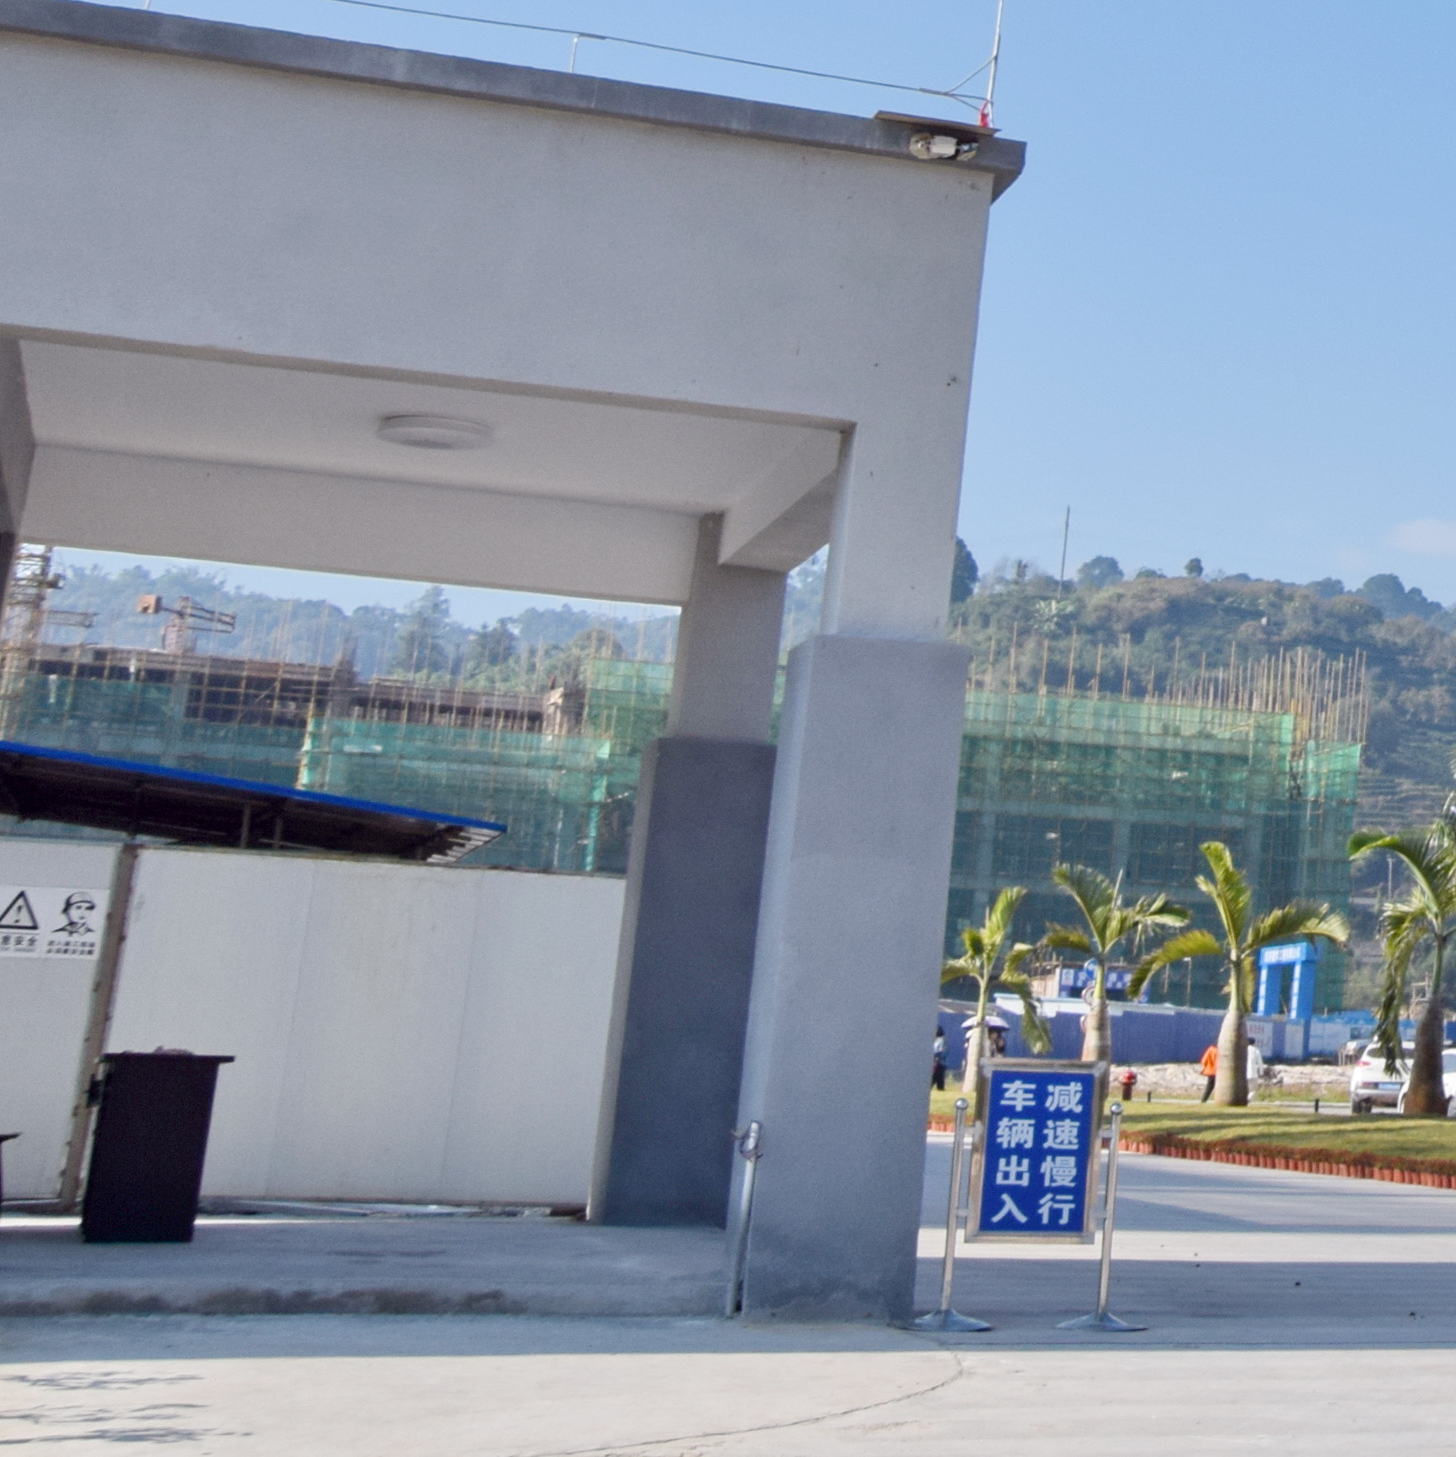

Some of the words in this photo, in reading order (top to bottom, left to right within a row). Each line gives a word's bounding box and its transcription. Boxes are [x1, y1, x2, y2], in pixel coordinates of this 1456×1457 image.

[991, 1080, 1036, 1223] 车辆出入
[1038, 1082, 1083, 1225] 减速慢行
